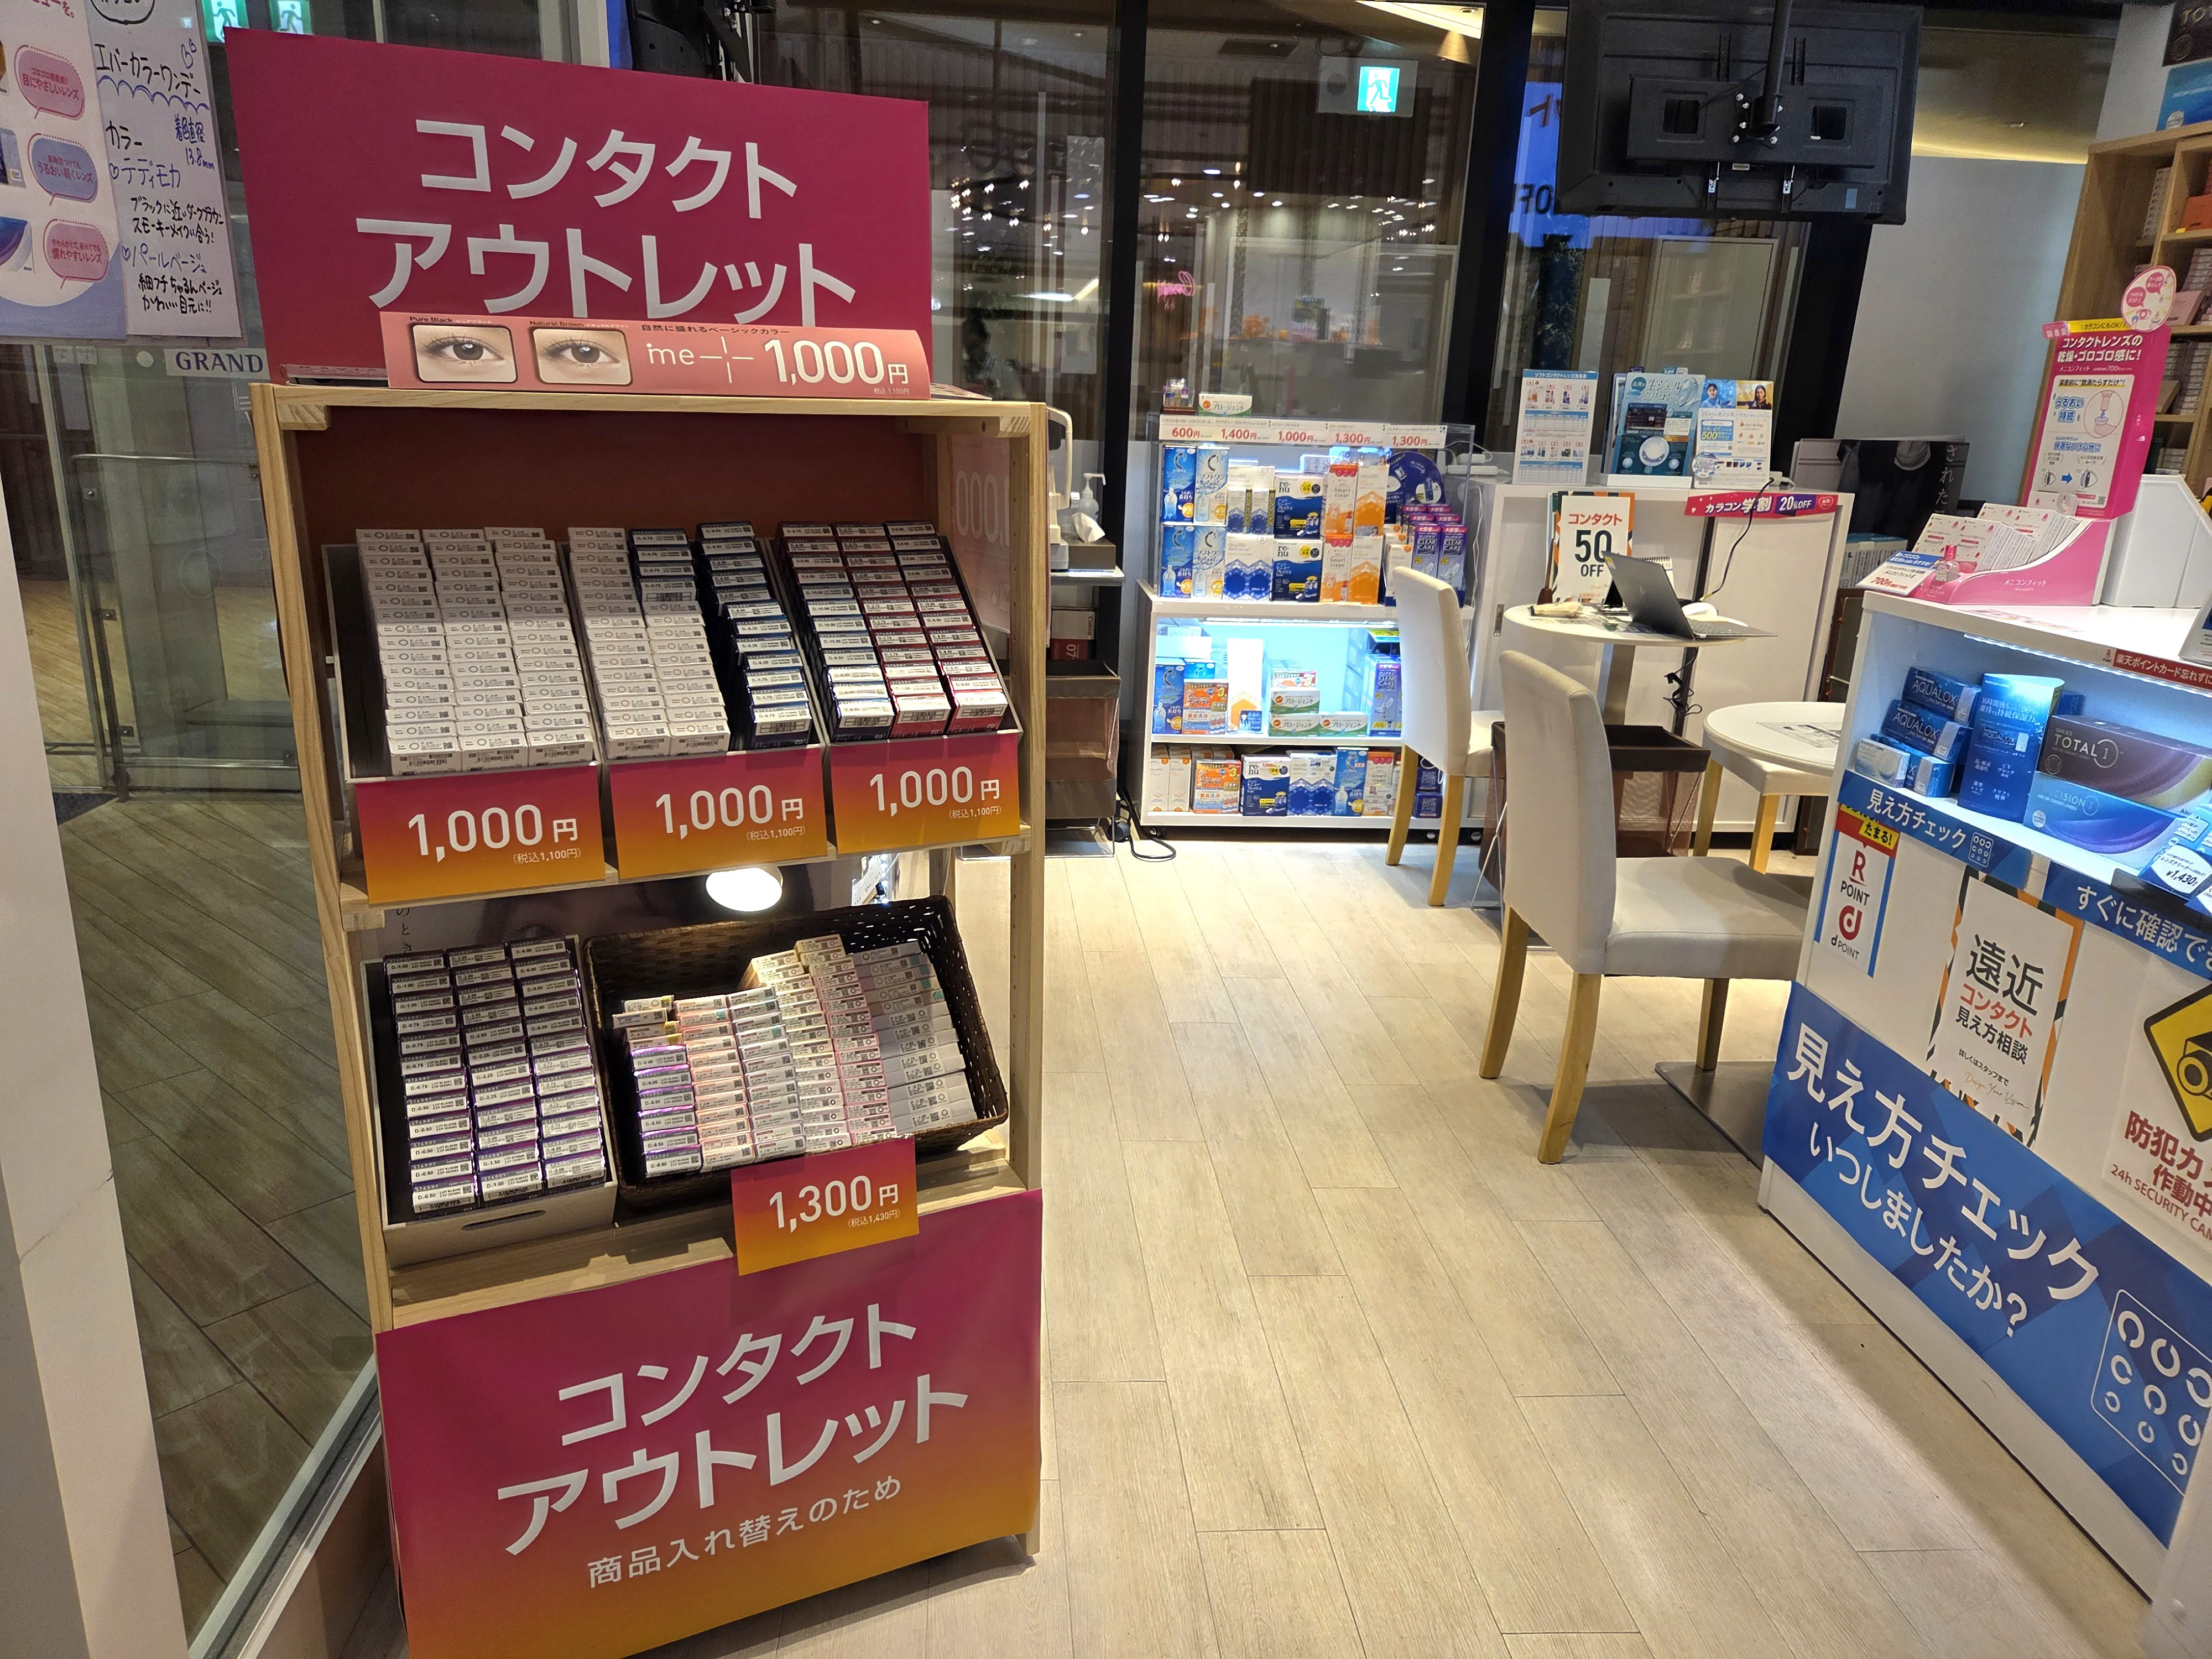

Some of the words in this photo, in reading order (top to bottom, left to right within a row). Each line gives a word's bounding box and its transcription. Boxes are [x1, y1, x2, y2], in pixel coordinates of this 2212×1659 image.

[22, 74, 80, 101] 目にやさしいレンズ
[105, 121, 143, 150] カラー
[415, 119, 797, 219] コンタクト
[132, 243, 207, 273] パールベージュ
[356, 218, 856, 327] アウトレット
[641, 324, 790, 335] 自然に盛れるベーシックカラー
[2062, 335, 2143, 348] コンタクトレンズの
[175, 351, 264, 373] GRAND
[2057, 349, 2142, 363] 乾燥・ゴロゴロ感に!
[1644, 392, 1671, 401] シリコン
[2055, 397, 2085, 408] うるおい
[2058, 410, 2075, 422] 持続
[1172, 427, 1200, 438] 600円
[1221, 428, 1257, 440] 1,400円
[1278, 431, 1313, 442] 1,000円
[1335, 432, 1371, 444] 1,300円
[1392, 436, 1428, 447] 1,300円
[2053, 441, 2102, 452] 快適なつけ心地に
[1568, 513, 1623, 526] コンタクト
[1580, 564, 1604, 577] OFF
[2116, 653, 2212, 685] 楽天ポイントカード忘れずに
[1912, 680, 1959, 706] AQUALOX
[1893, 712, 1941, 740] AQUALOX
[1983, 732, 2016, 744] AQUALOX
[2056, 727, 2073, 737] DAILIES
[2054, 733, 2098, 758] TOTAL
[1229, 768, 1237, 778] 3
[870, 766, 1000, 817] 1,000円
[656, 785, 803, 840] 1,000円
[948, 805, 1002, 820] (税込1,100円)
[1867, 789, 1966, 848] 見え方チェック
[408, 803, 578, 862] 1,000円
[746, 824, 806, 842] (税込1,100円)
[1864, 822, 1892, 846] たまる!
[513, 847, 581, 866] (税込1,100円)
[1851, 849, 1866, 882] R
[1840, 880, 1870, 906] POINT
[1838, 941, 1860, 961] POINT
[1966, 934, 2044, 1016] 遠近
[1960, 983, 2033, 1039] コンタクト
[1955, 1005, 2029, 1065] 見え方相談
[1958, 1048, 2010, 1087] 詳しくはスタッフまで
[1965, 1072, 1986, 1090] Design
[1986, 1082, 2004, 1097] Your
[2004, 1091, 2030, 1109] Vision
[1787, 1022, 2099, 1301] 見え方チェック
[2124, 1110, 2212, 1188] 防犯カ
[769, 1175, 898, 1233] 1,300円
[2111, 1164, 2132, 1186] 24h
[2133, 1178, 2189, 1222] SECURITY
[847, 1208, 901, 1229] (税込1,430円)
[1809, 1122, 2028, 1337] いつしましたか?
[557, 1302, 916, 1446] コンタクト
[497, 1374, 968, 1556] アウトレット
[588, 1475, 902, 1588] 商品入れ替えのため
